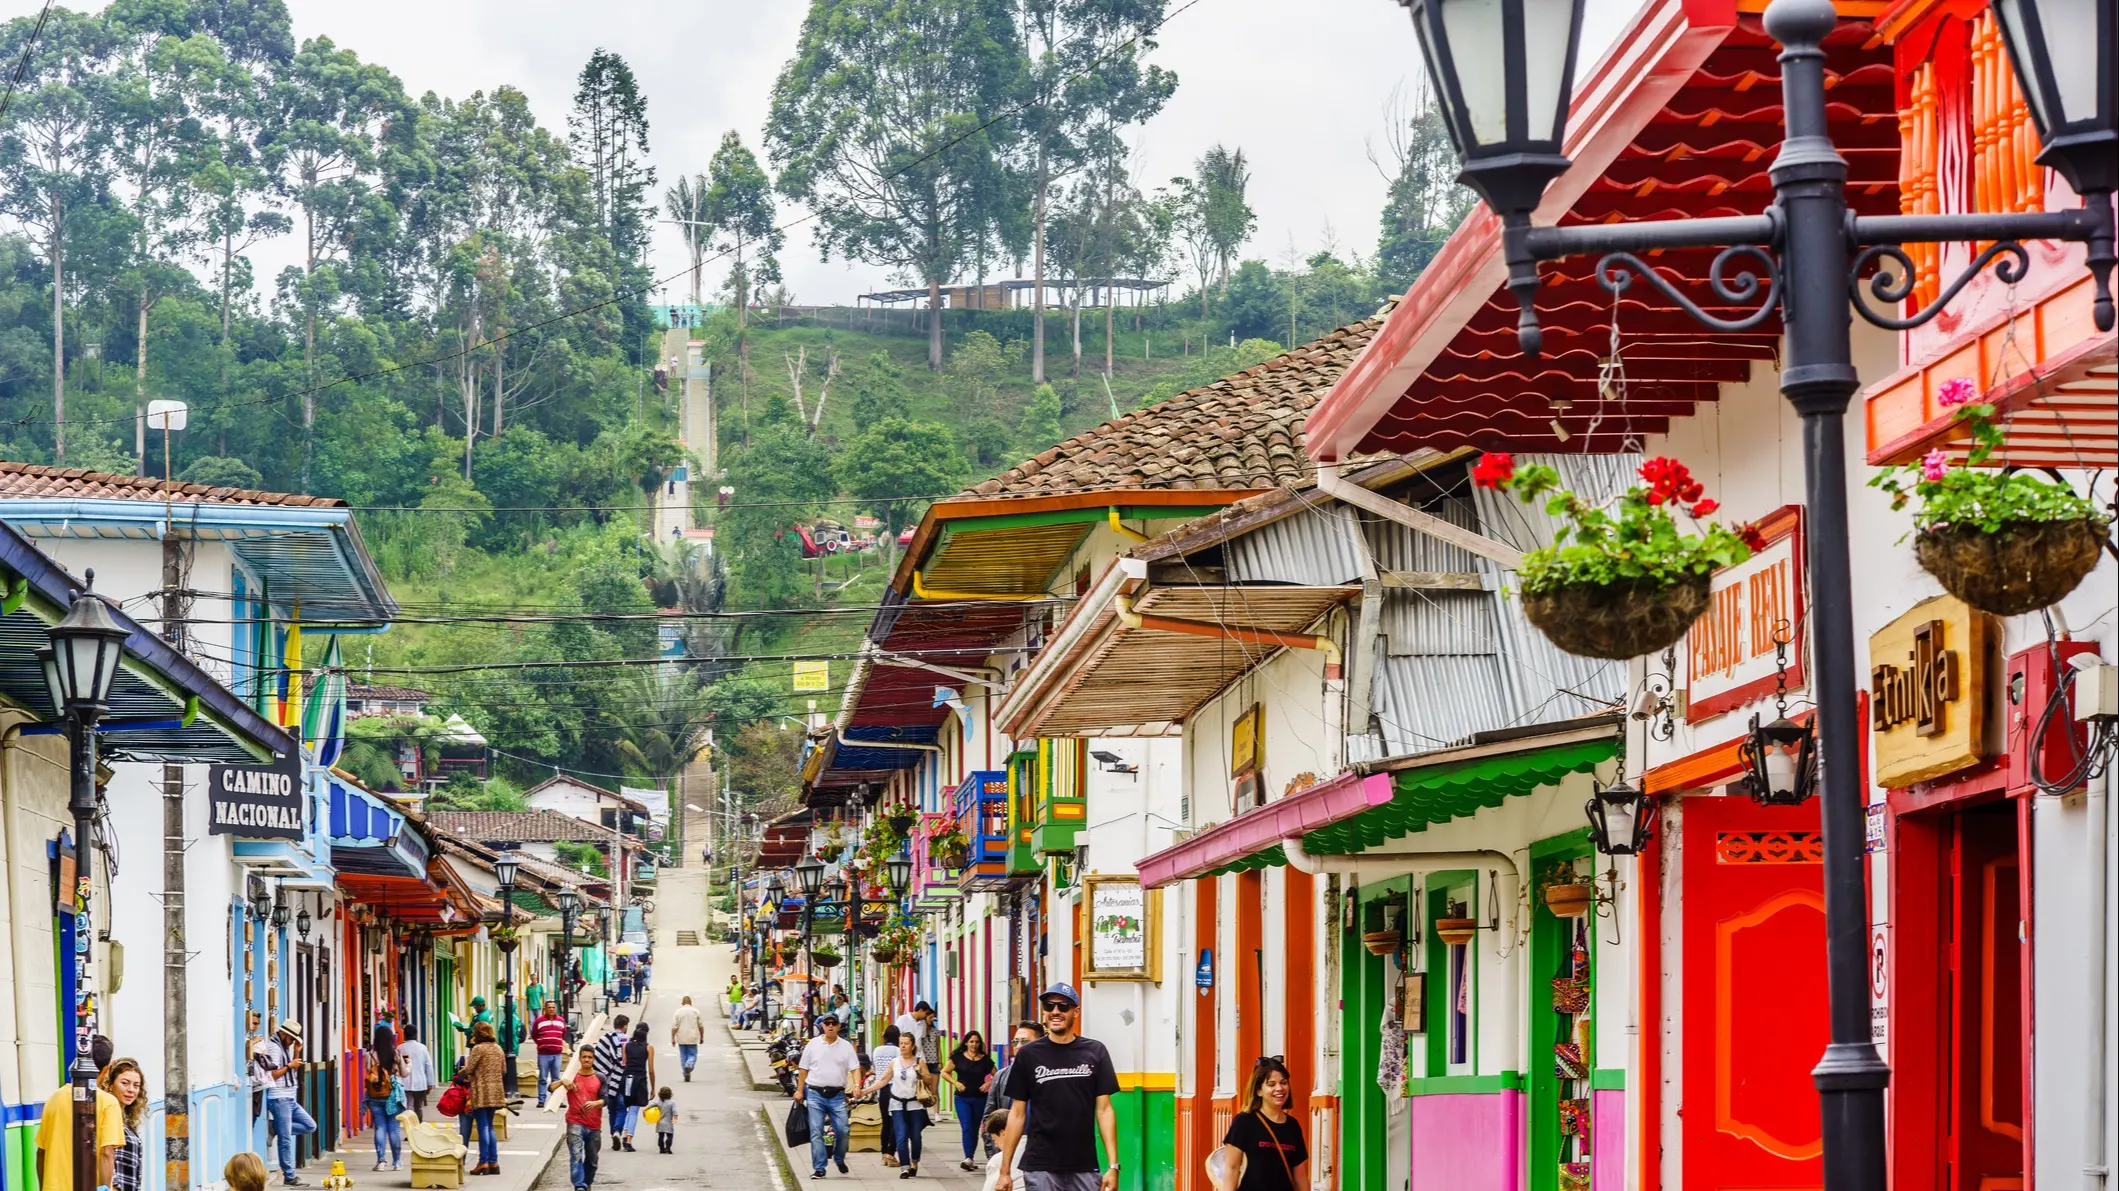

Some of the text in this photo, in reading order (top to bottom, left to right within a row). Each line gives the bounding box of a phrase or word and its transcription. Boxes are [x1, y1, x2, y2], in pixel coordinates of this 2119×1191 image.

[1692, 557, 1791, 682] PASAJE REAL
[1871, 620, 1957, 737] Etnika
[222, 769, 291, 796] CAMINO
[215, 801, 301, 830] NACIONAL
[1035, 1064, 1093, 1079] Dreamville
